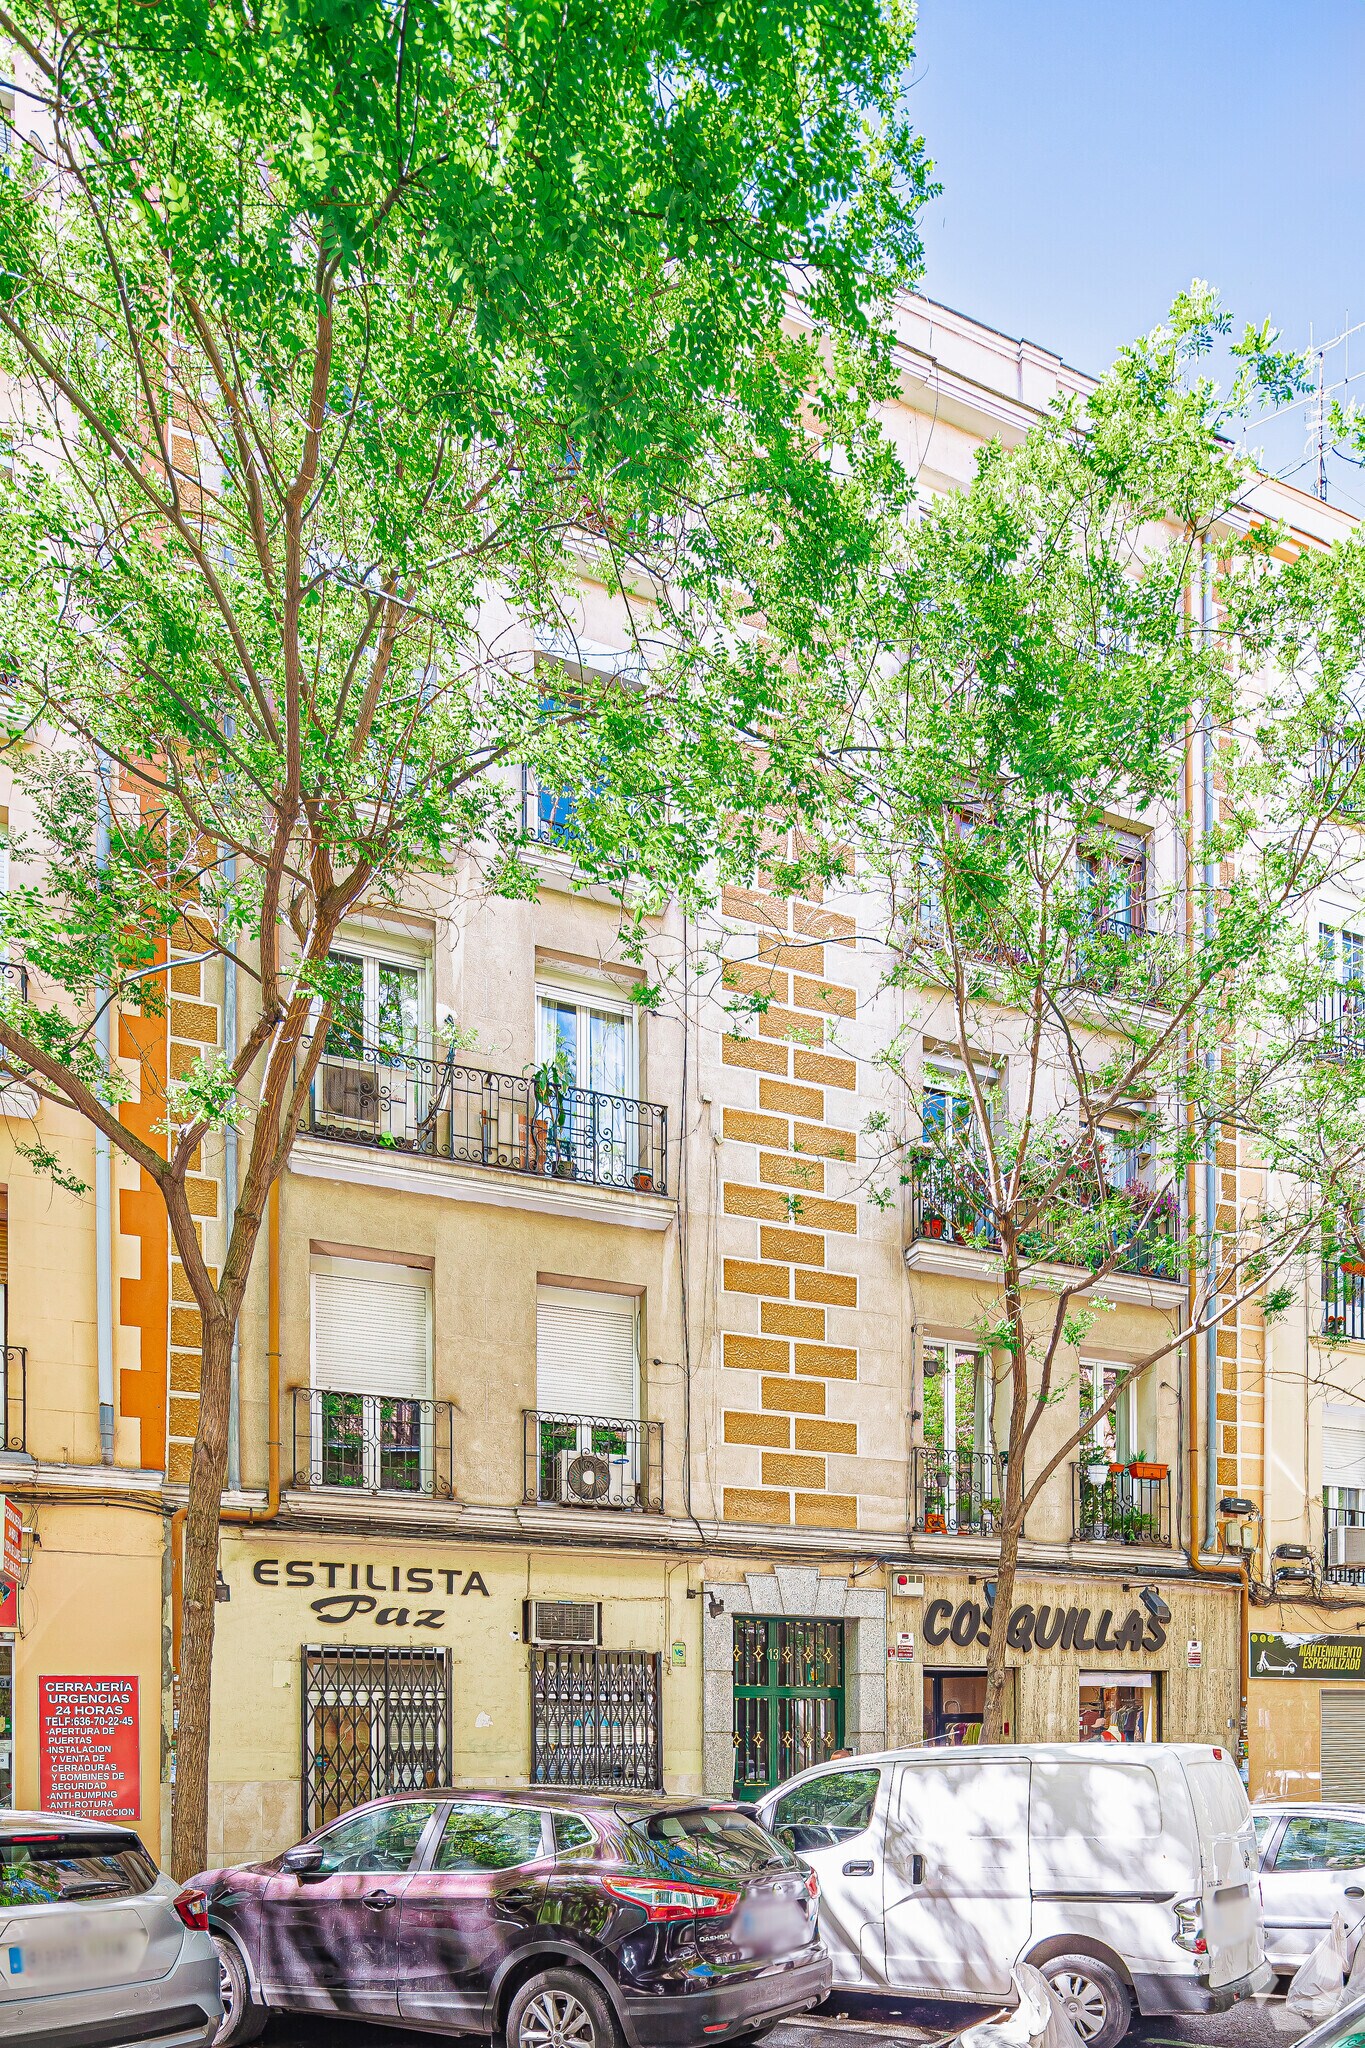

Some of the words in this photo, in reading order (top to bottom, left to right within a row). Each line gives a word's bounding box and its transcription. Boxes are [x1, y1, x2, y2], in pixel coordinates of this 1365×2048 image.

[252, 1558, 490, 1597] ESTILISTA
[310, 1594, 446, 1629] Paz
[768, 1648, 779, 1660] 13
[1298, 1644, 1363, 1659] MANTENIMIENTO
[1302, 1656, 1361, 1670] ESPECIALIZADO
[45, 1681, 133, 1692] CERRAJERÍA
[48, 1694, 130, 1704] URGENCIAS
[55, 1706, 71, 1715] 24
[74, 1706, 124, 1715] HORAS
[102, 1727, 115, 1735] DE
[48, 1736, 92, 1745] PUERTAS
[51, 1755, 58, 1763] Y
[60, 1755, 91, 1763] VENTA
[51, 1764, 117, 1772] CERRADURAS
[51, 1773, 58, 1781] Y
[60, 1773, 110, 1781] BOMBINES
[51, 1782, 107, 1790] SEGURIDAD
